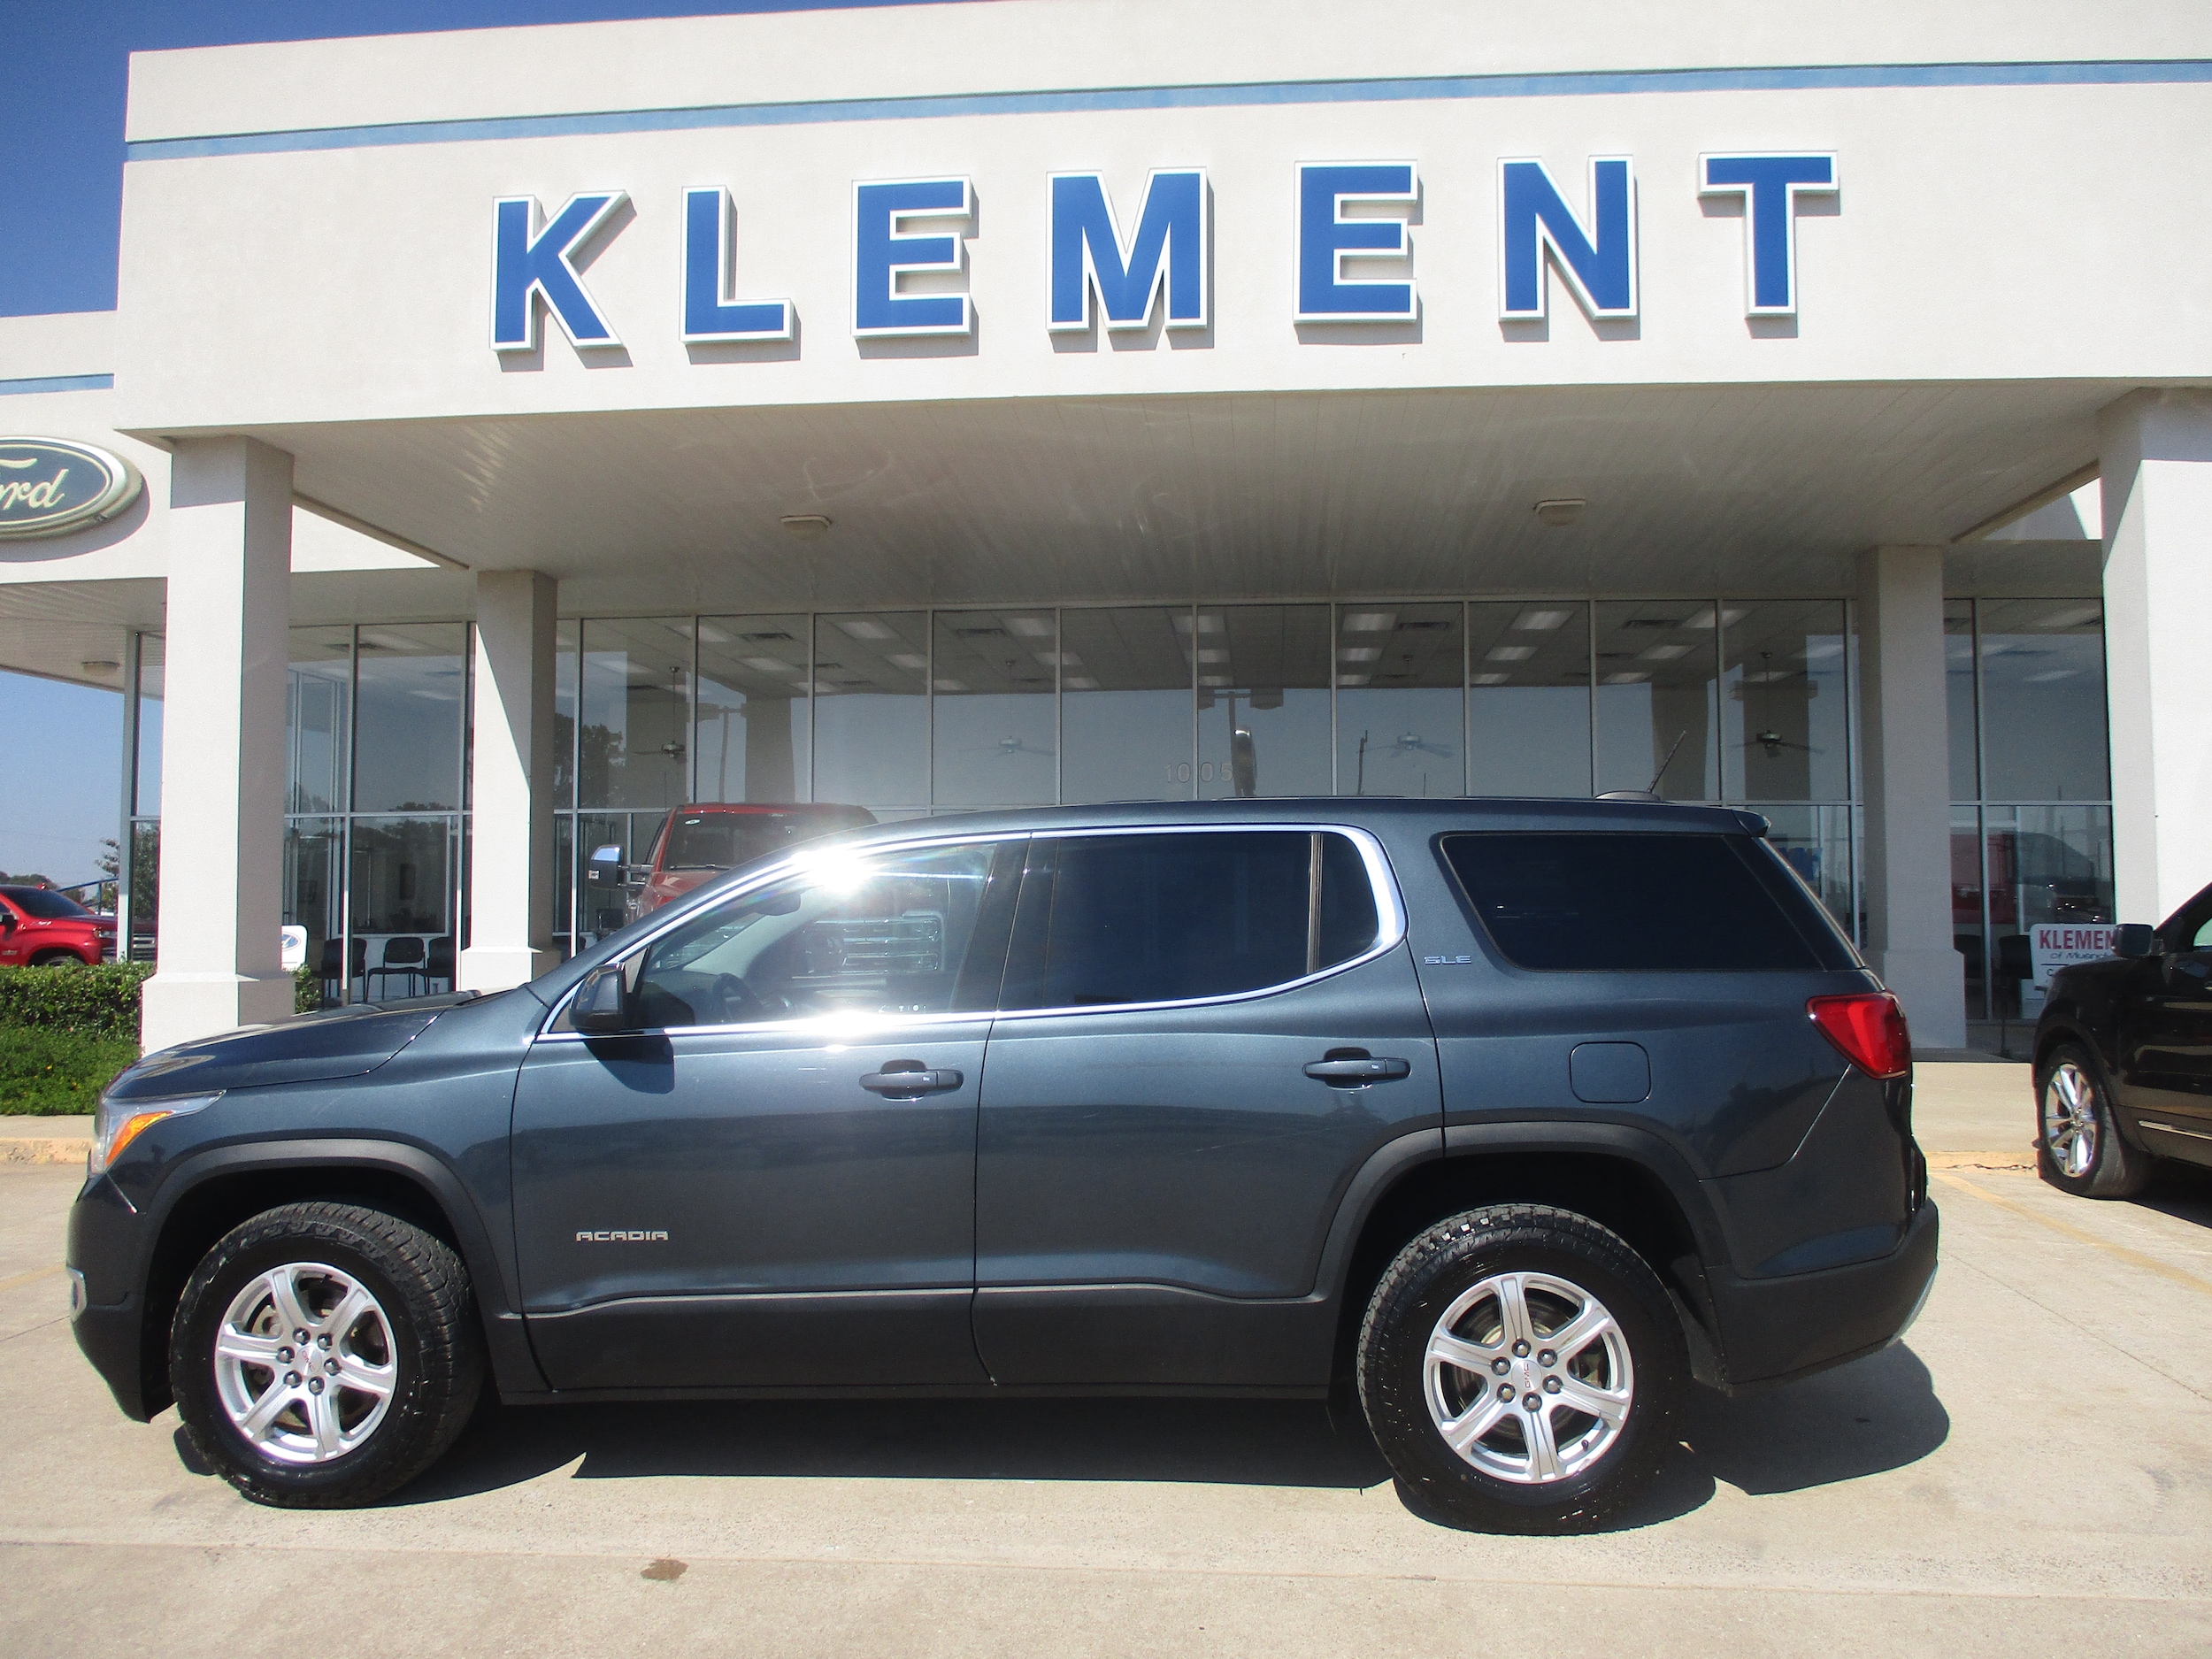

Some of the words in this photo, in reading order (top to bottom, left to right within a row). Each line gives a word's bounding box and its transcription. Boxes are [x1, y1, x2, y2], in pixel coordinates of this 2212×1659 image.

[489, 150, 1839, 350] KLEMENT
[2039, 930, 2115, 949] KLEMEN
[1425, 956, 1471, 964] SLE
[575, 1231, 669, 1241] ACADIA
